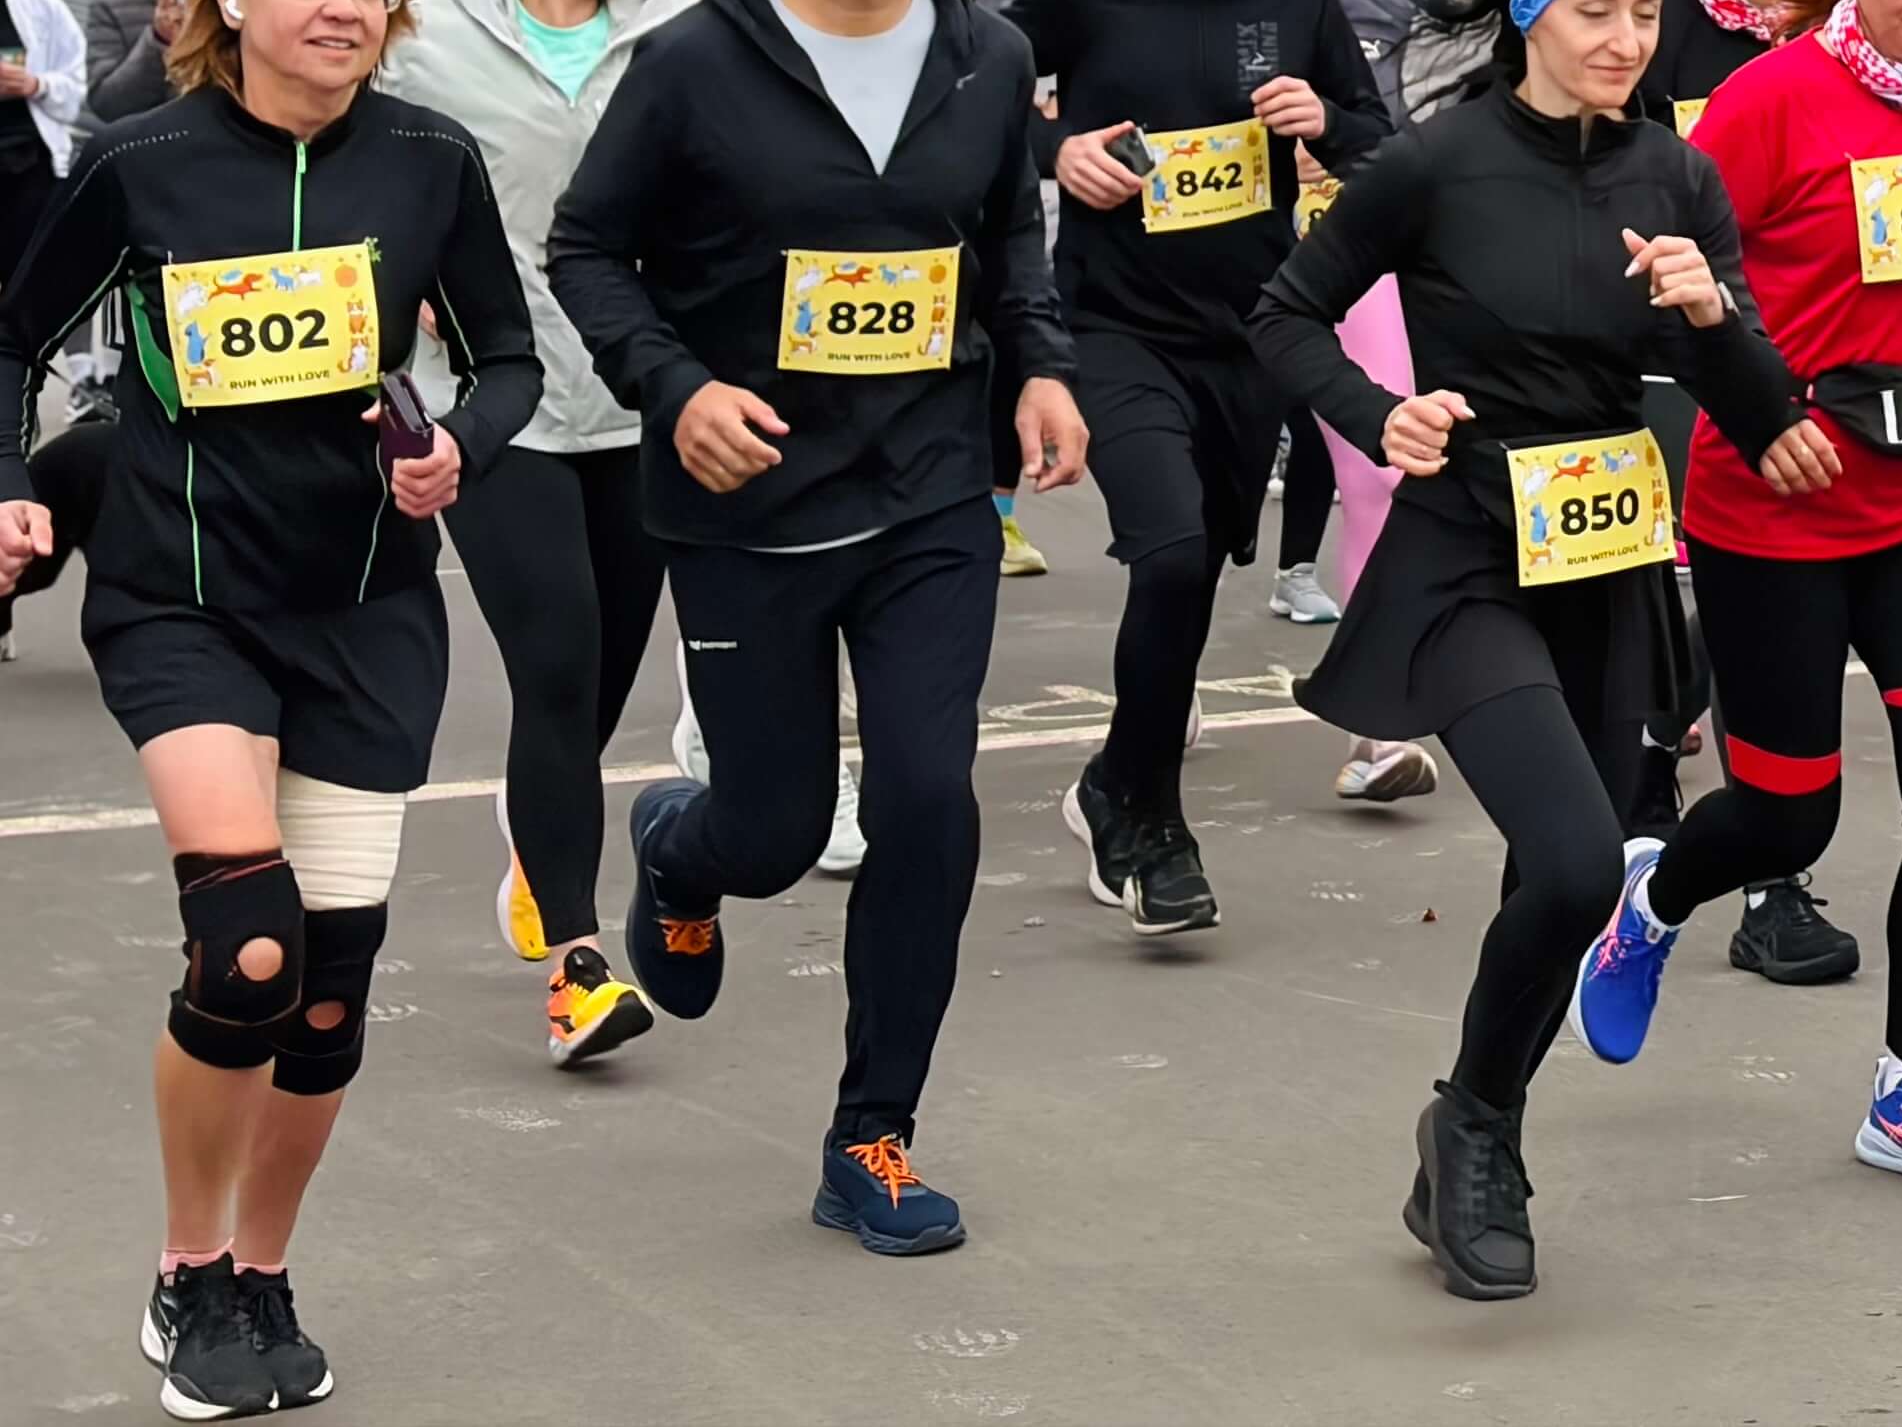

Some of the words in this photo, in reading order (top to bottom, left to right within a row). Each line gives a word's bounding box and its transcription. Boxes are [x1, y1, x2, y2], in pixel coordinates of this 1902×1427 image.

[1176, 162, 1244, 198] 842
[220, 308, 330, 358] 802
[826, 301, 915, 335] 828
[828, 352, 850, 361] RUN
[853, 353, 882, 362] WITH
[885, 351, 911, 361] LOVE
[229, 380, 257, 391] RUN
[261, 374, 295, 387] WITH
[298, 370, 331, 382] LOVE
[1560, 488, 1640, 536] 850
[1567, 556, 1589, 566] RUN
[1590, 551, 1616, 562] WITH
[1617, 544, 1640, 557] LOVE
